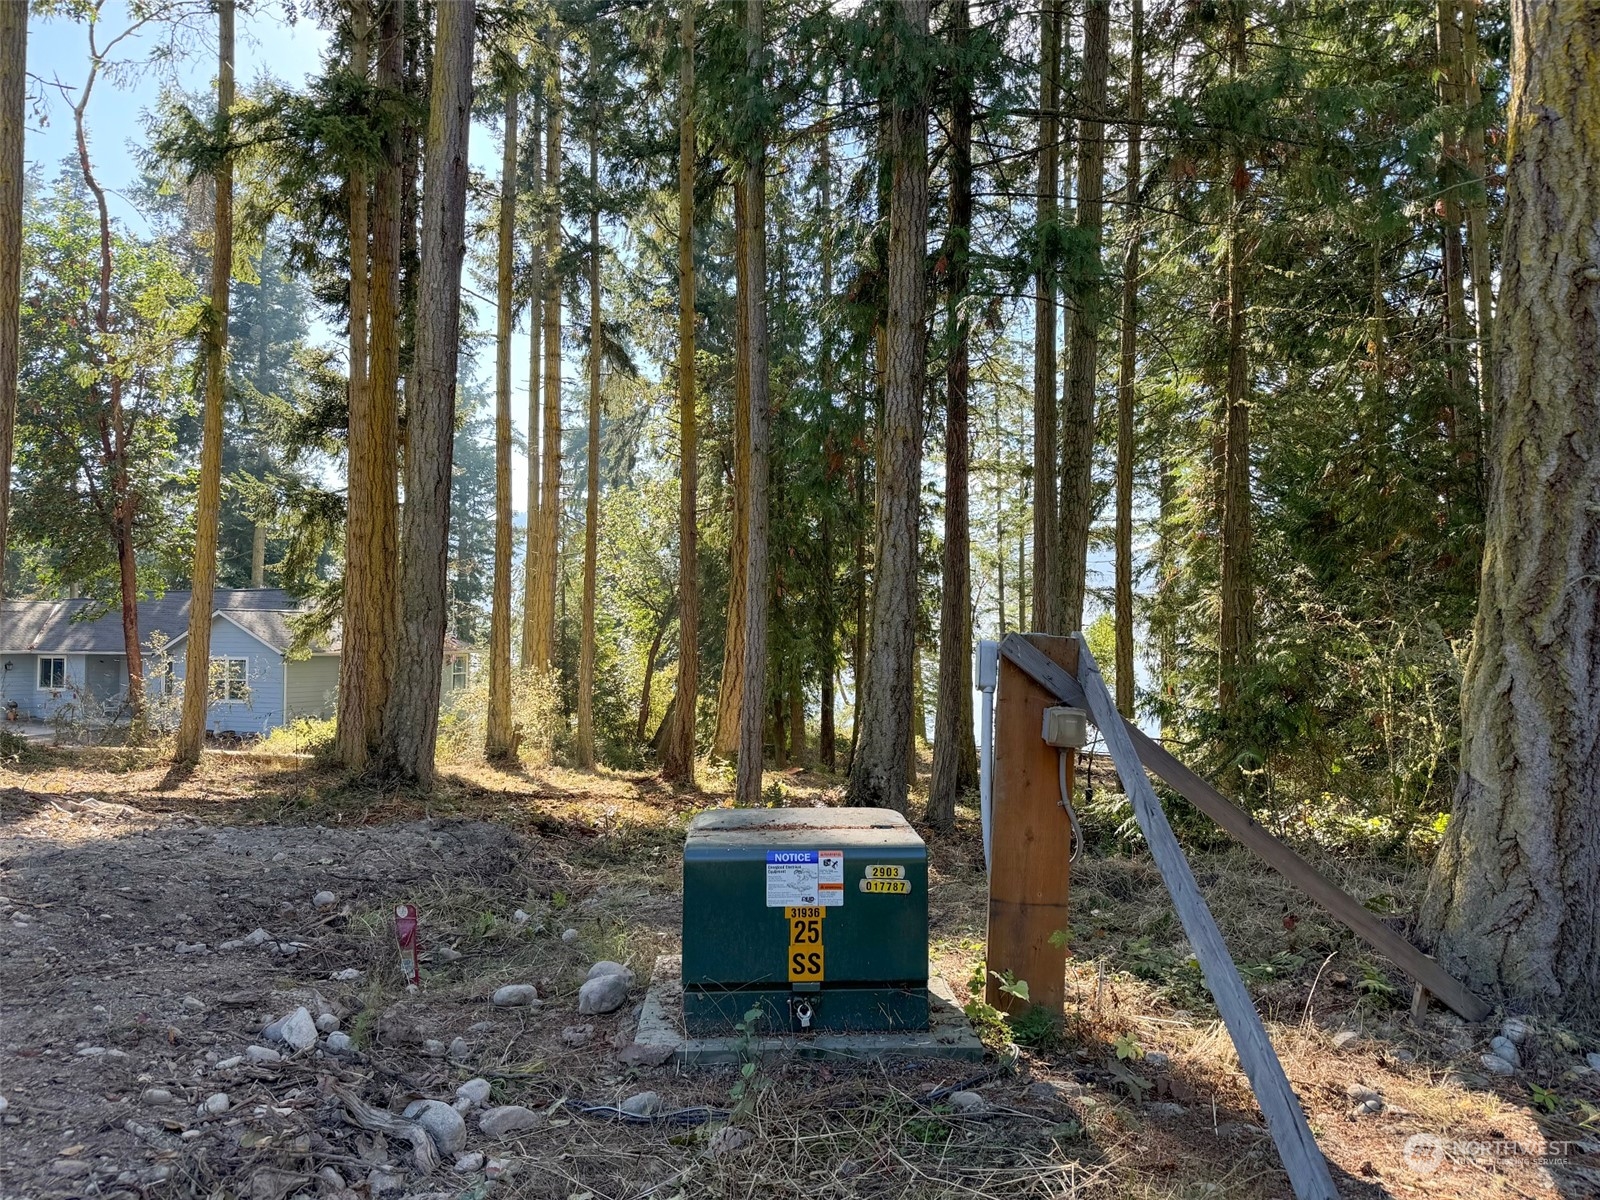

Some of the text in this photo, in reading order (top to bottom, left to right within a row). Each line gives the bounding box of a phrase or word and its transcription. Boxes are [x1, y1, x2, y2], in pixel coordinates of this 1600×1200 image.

[774, 853, 811, 862] NOTICE
[872, 867, 899, 877] 2903
[866, 881, 905, 892] 017787
[791, 907, 820, 918] 31936
[794, 920, 819, 944] 25
[792, 952, 821, 975] SS
